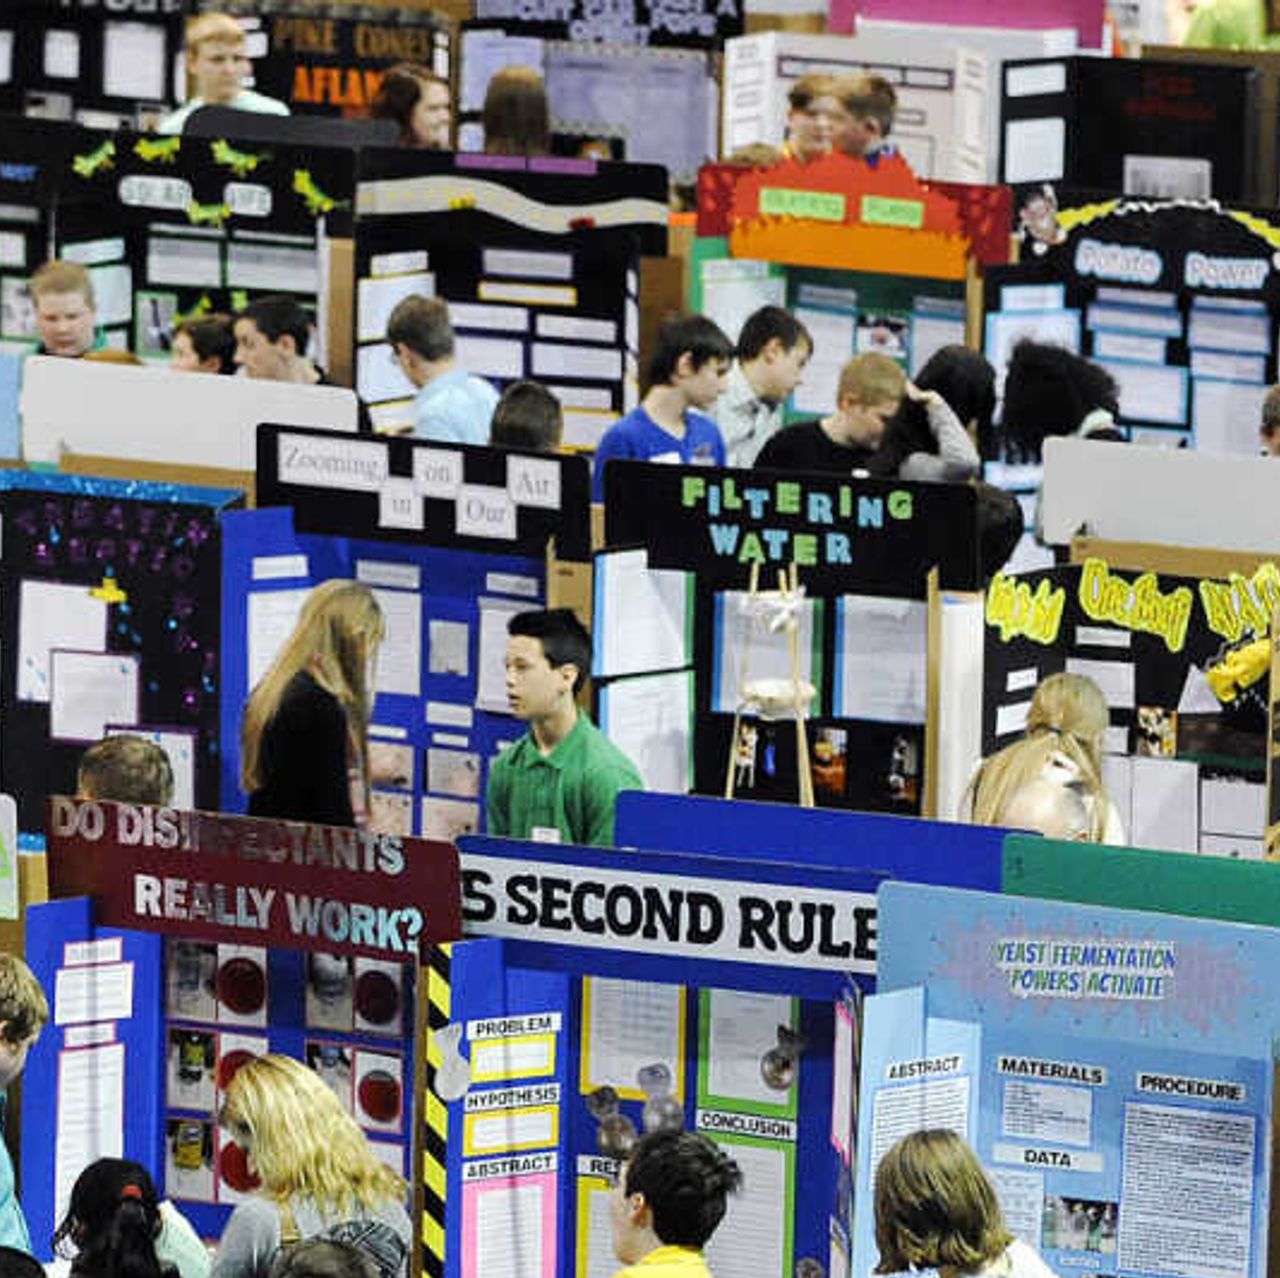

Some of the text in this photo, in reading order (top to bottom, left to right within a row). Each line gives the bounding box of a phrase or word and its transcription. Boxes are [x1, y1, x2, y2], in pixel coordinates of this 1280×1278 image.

[285, 447, 378, 482] Zooming
[466, 498, 505, 524] Our
[682, 477, 913, 528] FILTERING
[709, 524, 852, 565] WATER
[52, 799, 104, 841] DO
[134, 874, 423, 955] REALLY WORK?
[506, 875, 721, 946] SECOND
[738, 896, 877, 961] RULE
[997, 941, 1175, 969] YEAST FERMENTATION
[1087, 971, 1162, 997] ACTIVATE
[475, 1016, 552, 1036] PROBLEM
[889, 1056, 959, 1079] ABSTRACT
[1001, 1059, 1102, 1084] MATERIALS
[467, 1087, 558, 1109] HYPOTHESIS
[1141, 1075, 1242, 1100] PROCEDURE
[700, 1113, 792, 1137] CONCLUSION
[467, 1156, 553, 1178] ABSTRACT
[1024, 1150, 1071, 1167] DATA
